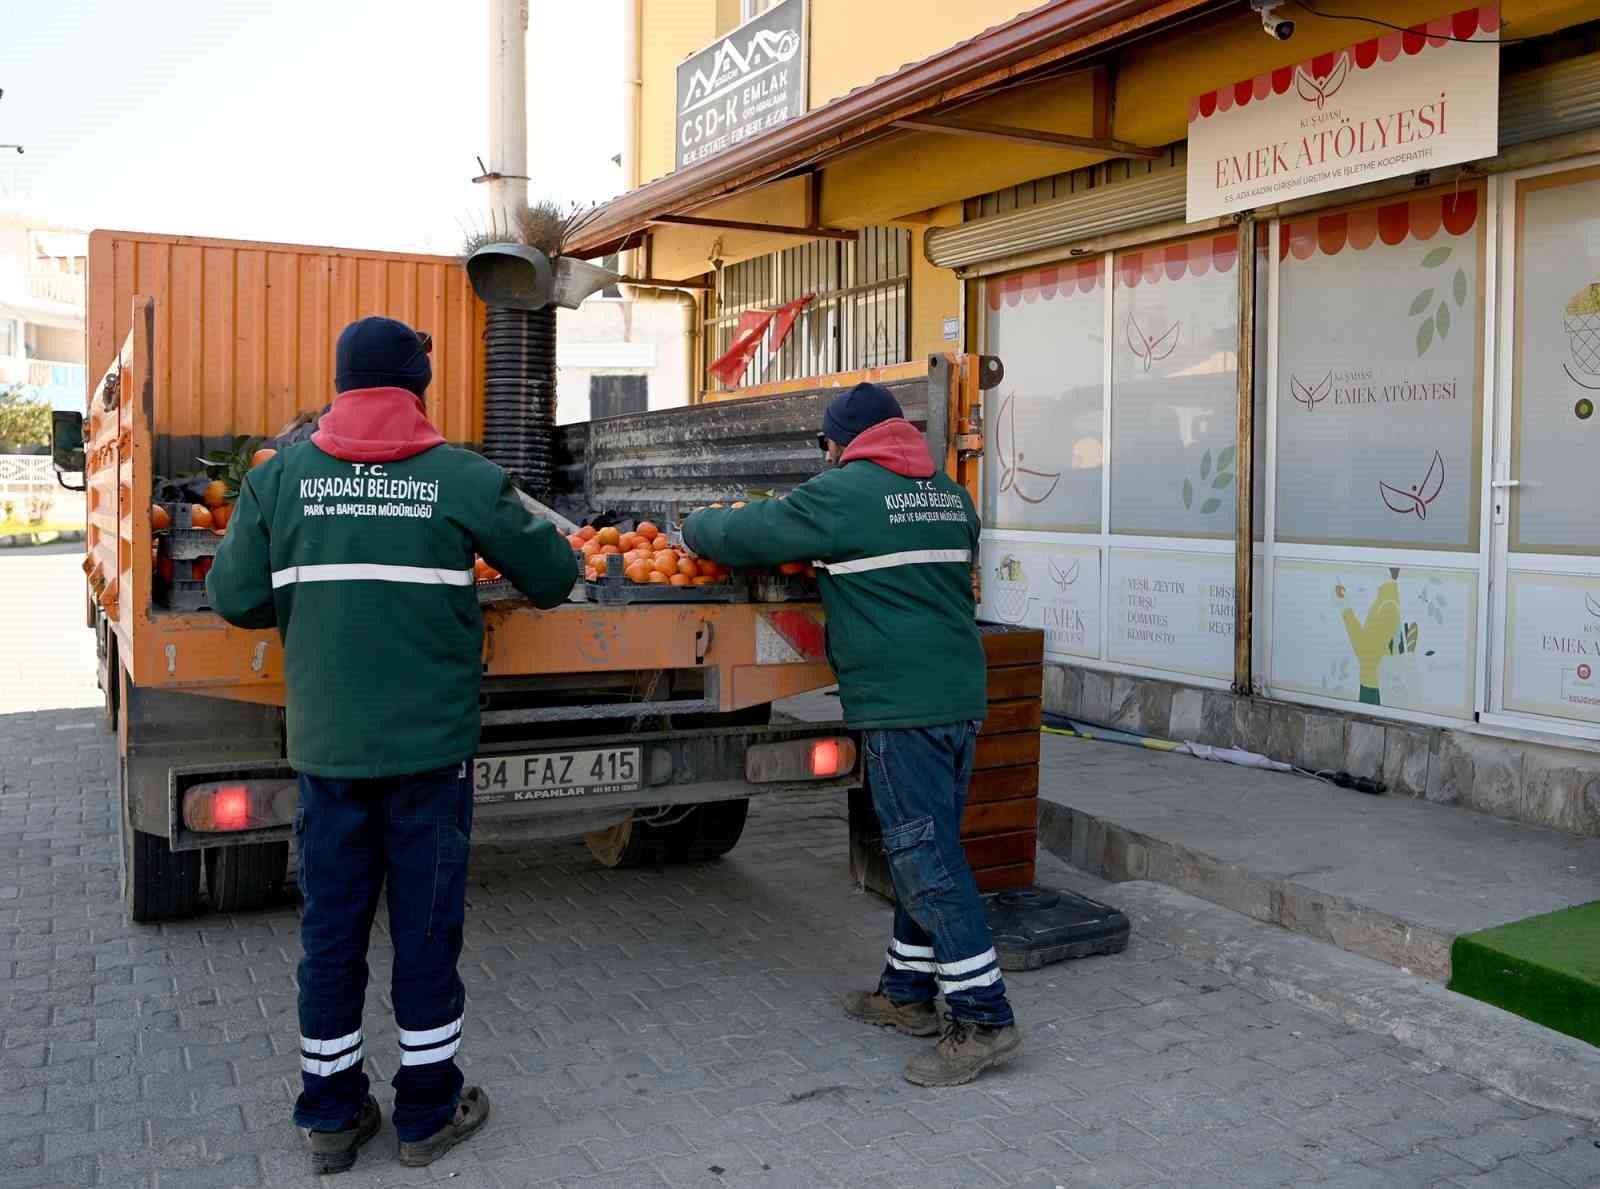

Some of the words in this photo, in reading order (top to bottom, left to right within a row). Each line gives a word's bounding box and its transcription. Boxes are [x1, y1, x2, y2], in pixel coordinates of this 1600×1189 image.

[743, 71, 788, 104] EMLAK
[682, 96, 738, 147] CSD-K
[1215, 141, 1288, 190] EMEK
[1295, 92, 1449, 169] ATÖLYESİ
[1335, 386, 1377, 405] EMEK
[1382, 377, 1457, 402] ATÖLYESİ
[351, 463, 389, 477] T.C.
[300, 477, 364, 502] KUŞADASI
[367, 475, 439, 503] BELEDİYESİ
[916, 481, 936, 490] T.C.
[304, 504, 324, 517] PARK
[325, 507, 335, 515] ve
[336, 503, 377, 517] BAHÇELER
[378, 502, 432, 519] MÜDÜRLÜĞÜ
[884, 492, 928, 511] KUŞADASI
[889, 513, 907, 525] PARK
[907, 512, 914, 522] VE
[1543, 635, 1586, 655] EMEK
[476, 760, 508, 791] 34
[523, 755, 575, 787] FAZ
[590, 751, 634, 781] 415
[514, 787, 585, 801] KAPANLAR
